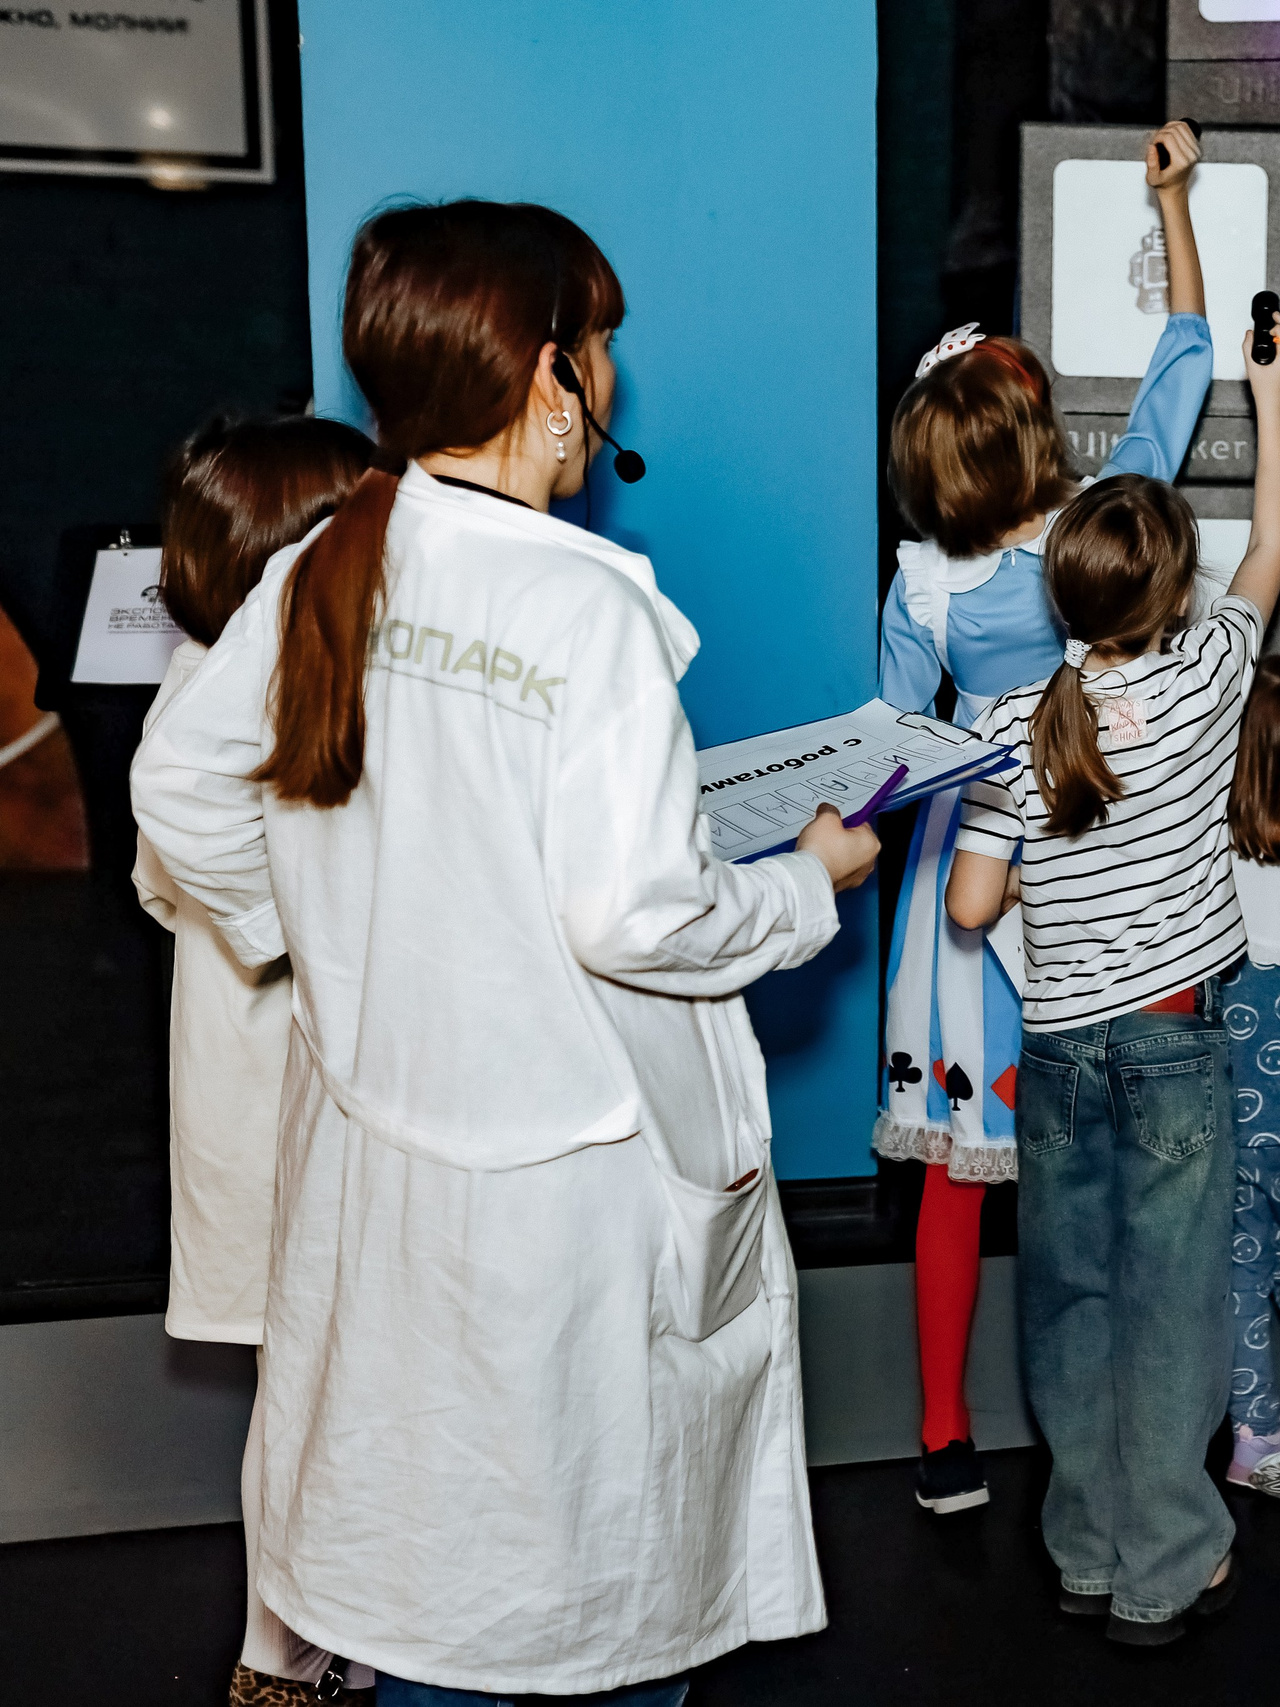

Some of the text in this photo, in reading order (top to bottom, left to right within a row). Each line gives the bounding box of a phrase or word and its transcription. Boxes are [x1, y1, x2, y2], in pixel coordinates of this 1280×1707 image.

[110, 607, 168, 615] ЭКСПО
[109, 614, 172, 622] ВРЕМЕН
[368, 619, 567, 716] ОПАРК
[1114, 730, 1142, 742] SHINE
[842, 738, 862, 747] с
